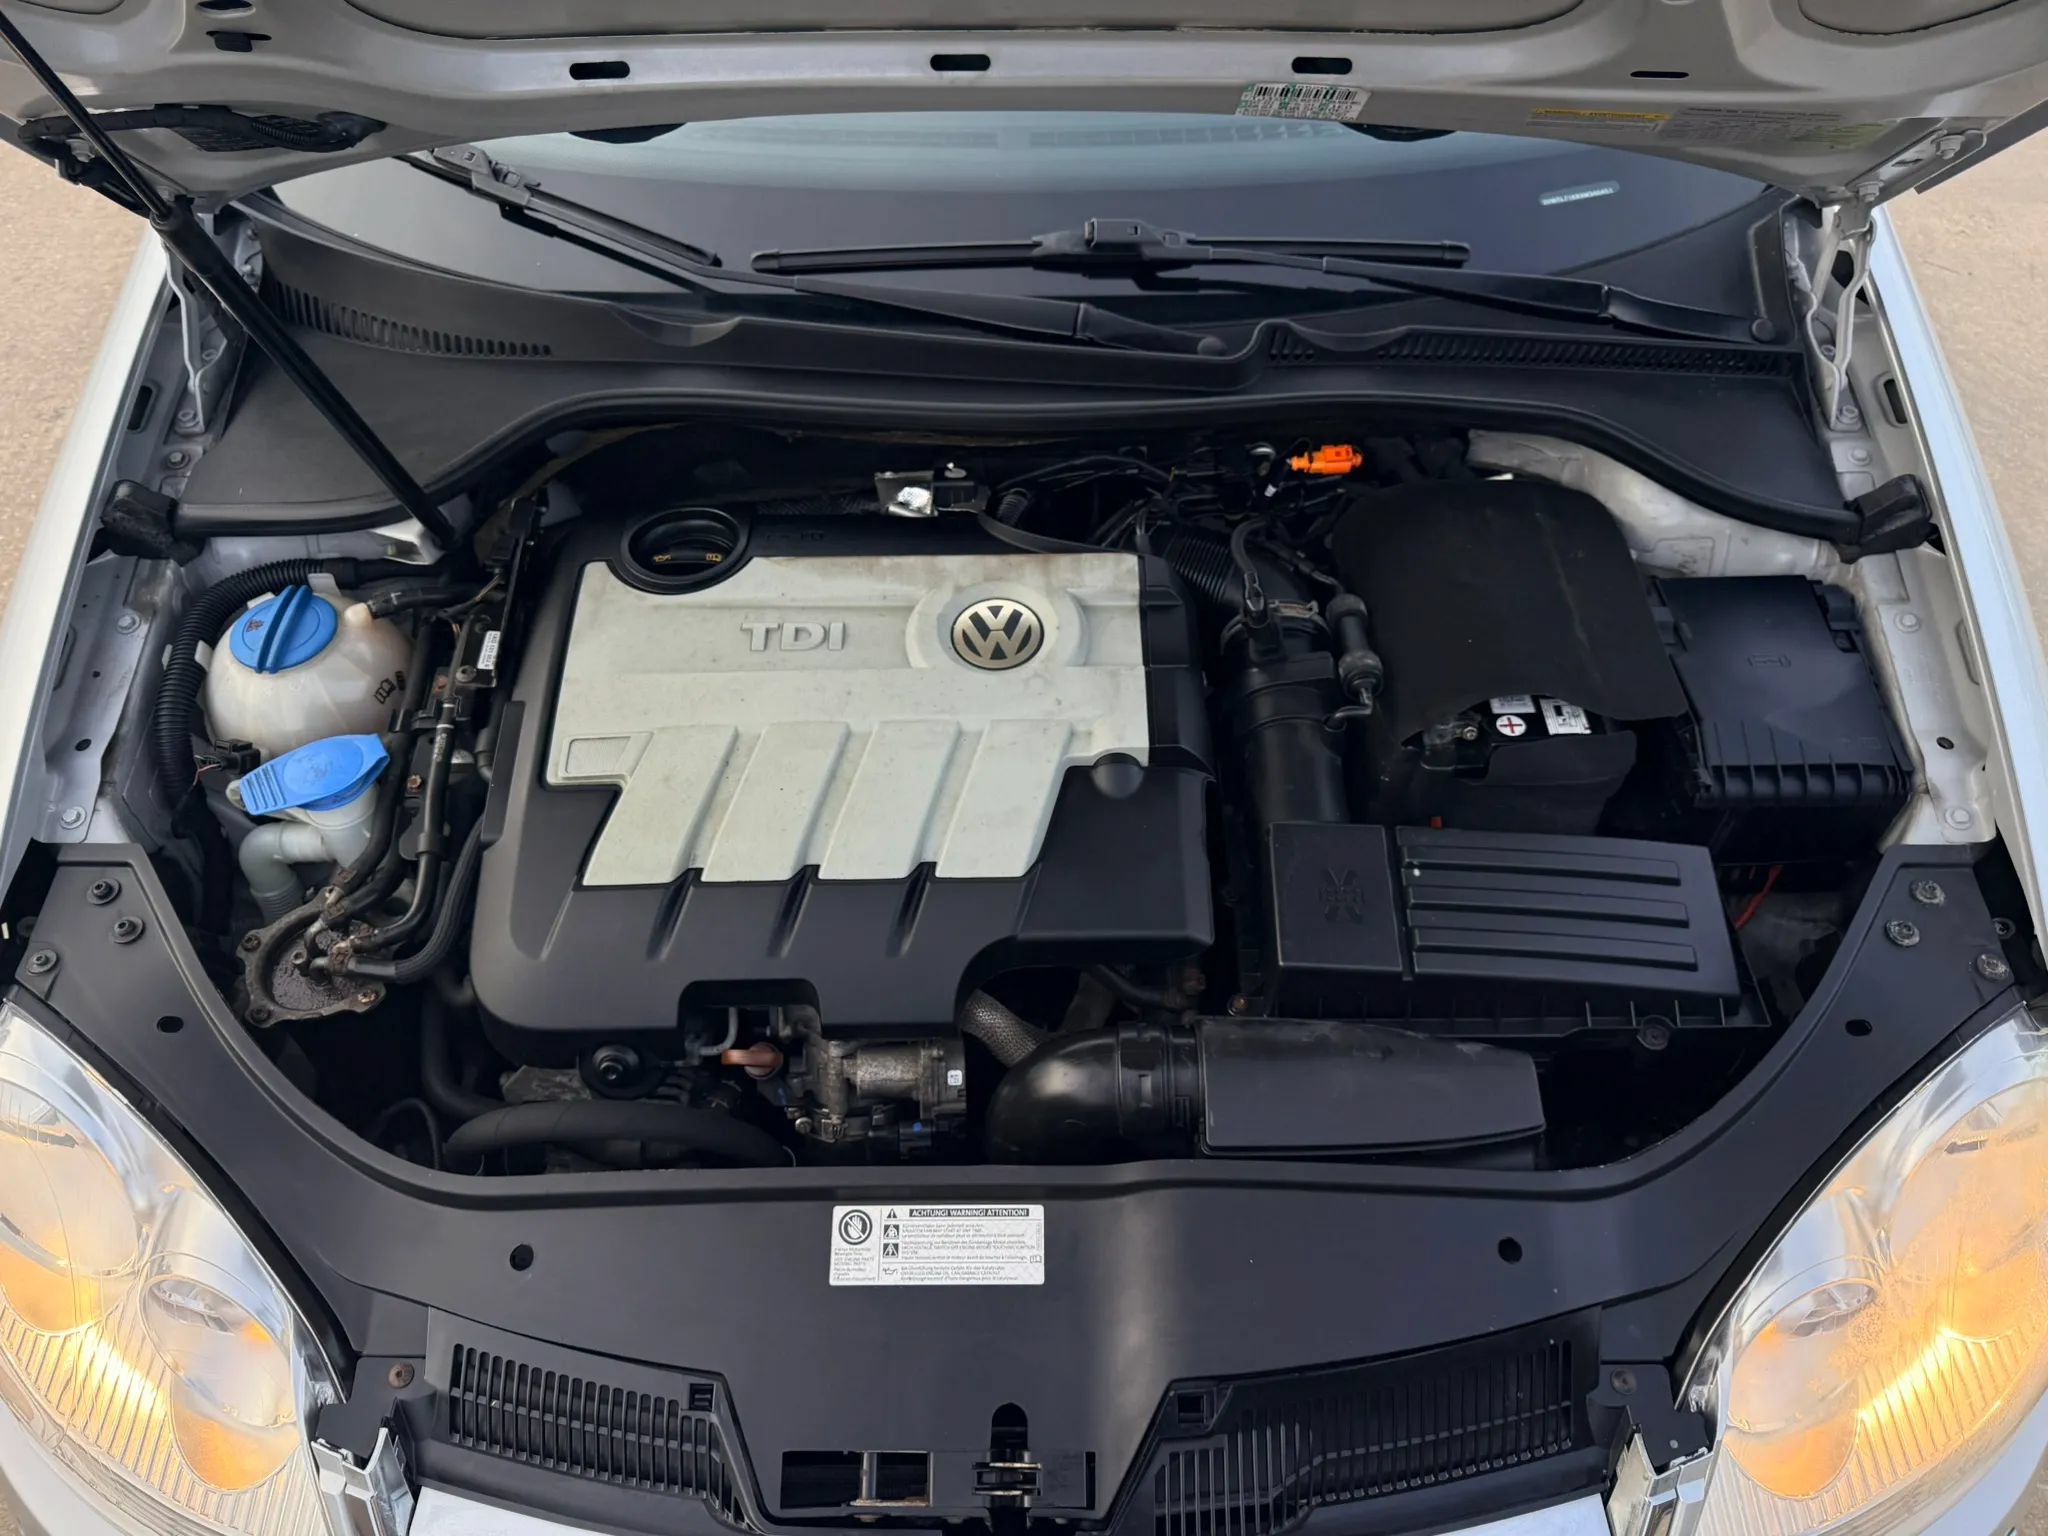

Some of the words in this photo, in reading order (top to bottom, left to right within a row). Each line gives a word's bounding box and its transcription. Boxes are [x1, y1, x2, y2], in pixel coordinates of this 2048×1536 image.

[741, 621, 846, 651] TDI
[952, 598, 1043, 670] VW
[911, 1208, 948, 1217] ACHTUNG!
[949, 1208, 986, 1217] WARNING!
[987, 1208, 1028, 1217] ATTENTION!
